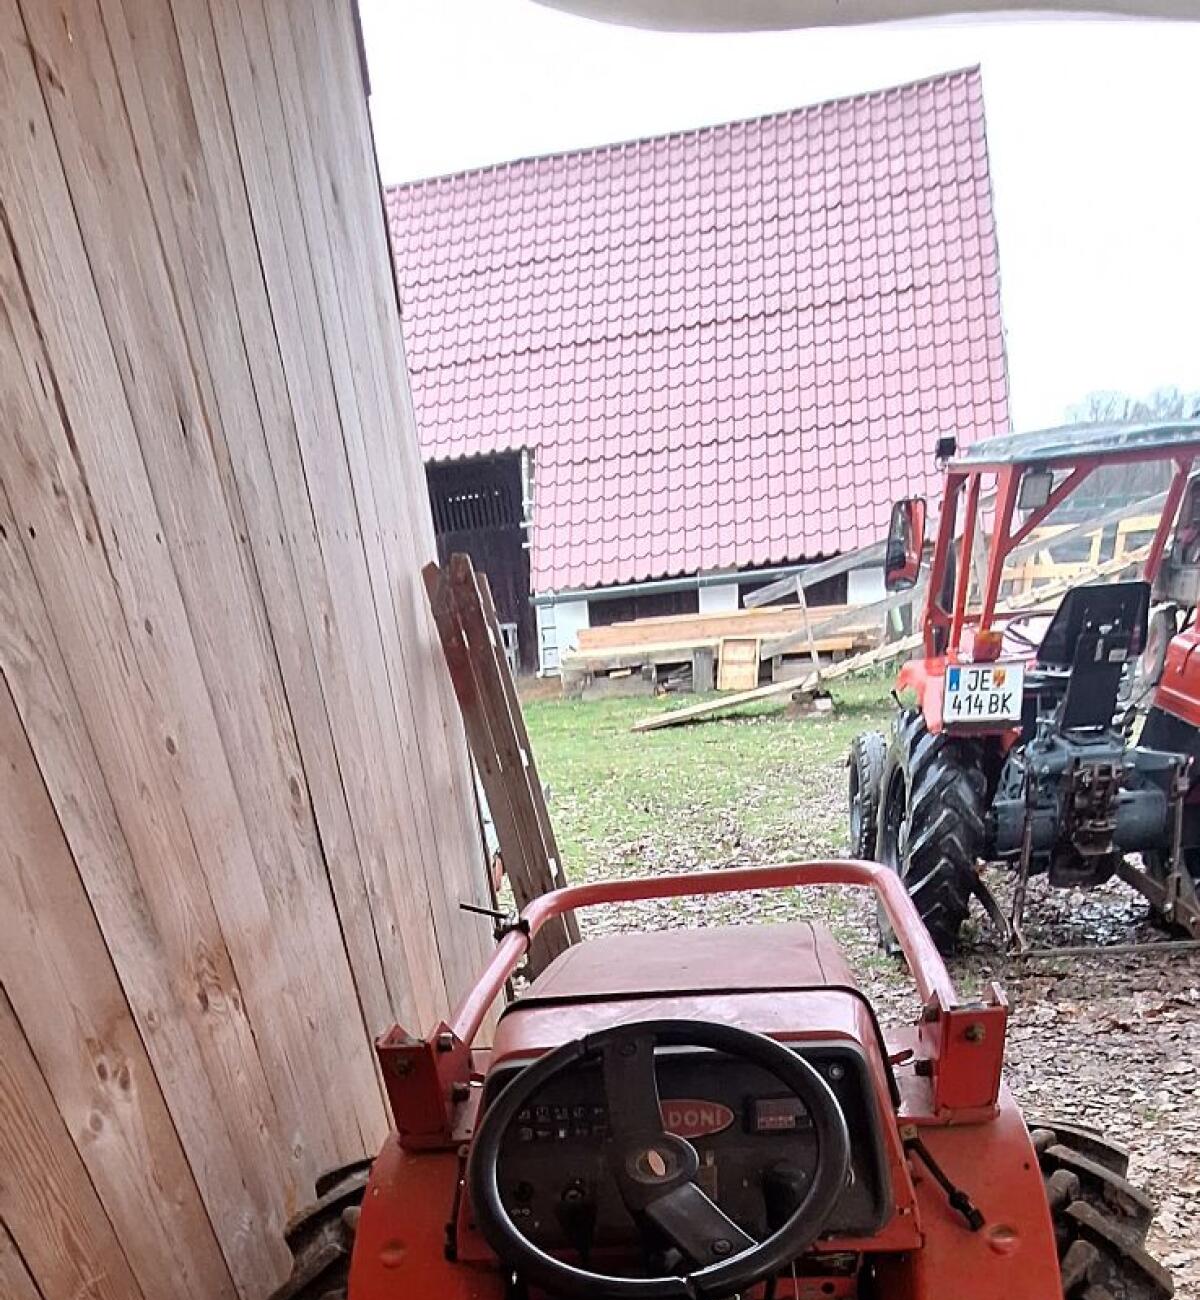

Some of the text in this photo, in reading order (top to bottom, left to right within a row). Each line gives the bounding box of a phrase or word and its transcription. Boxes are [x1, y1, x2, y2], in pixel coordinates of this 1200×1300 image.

[967, 669, 992, 692] JE
[952, 692, 1012, 715] 414 BK
[669, 1110, 721, 1127] DONI
